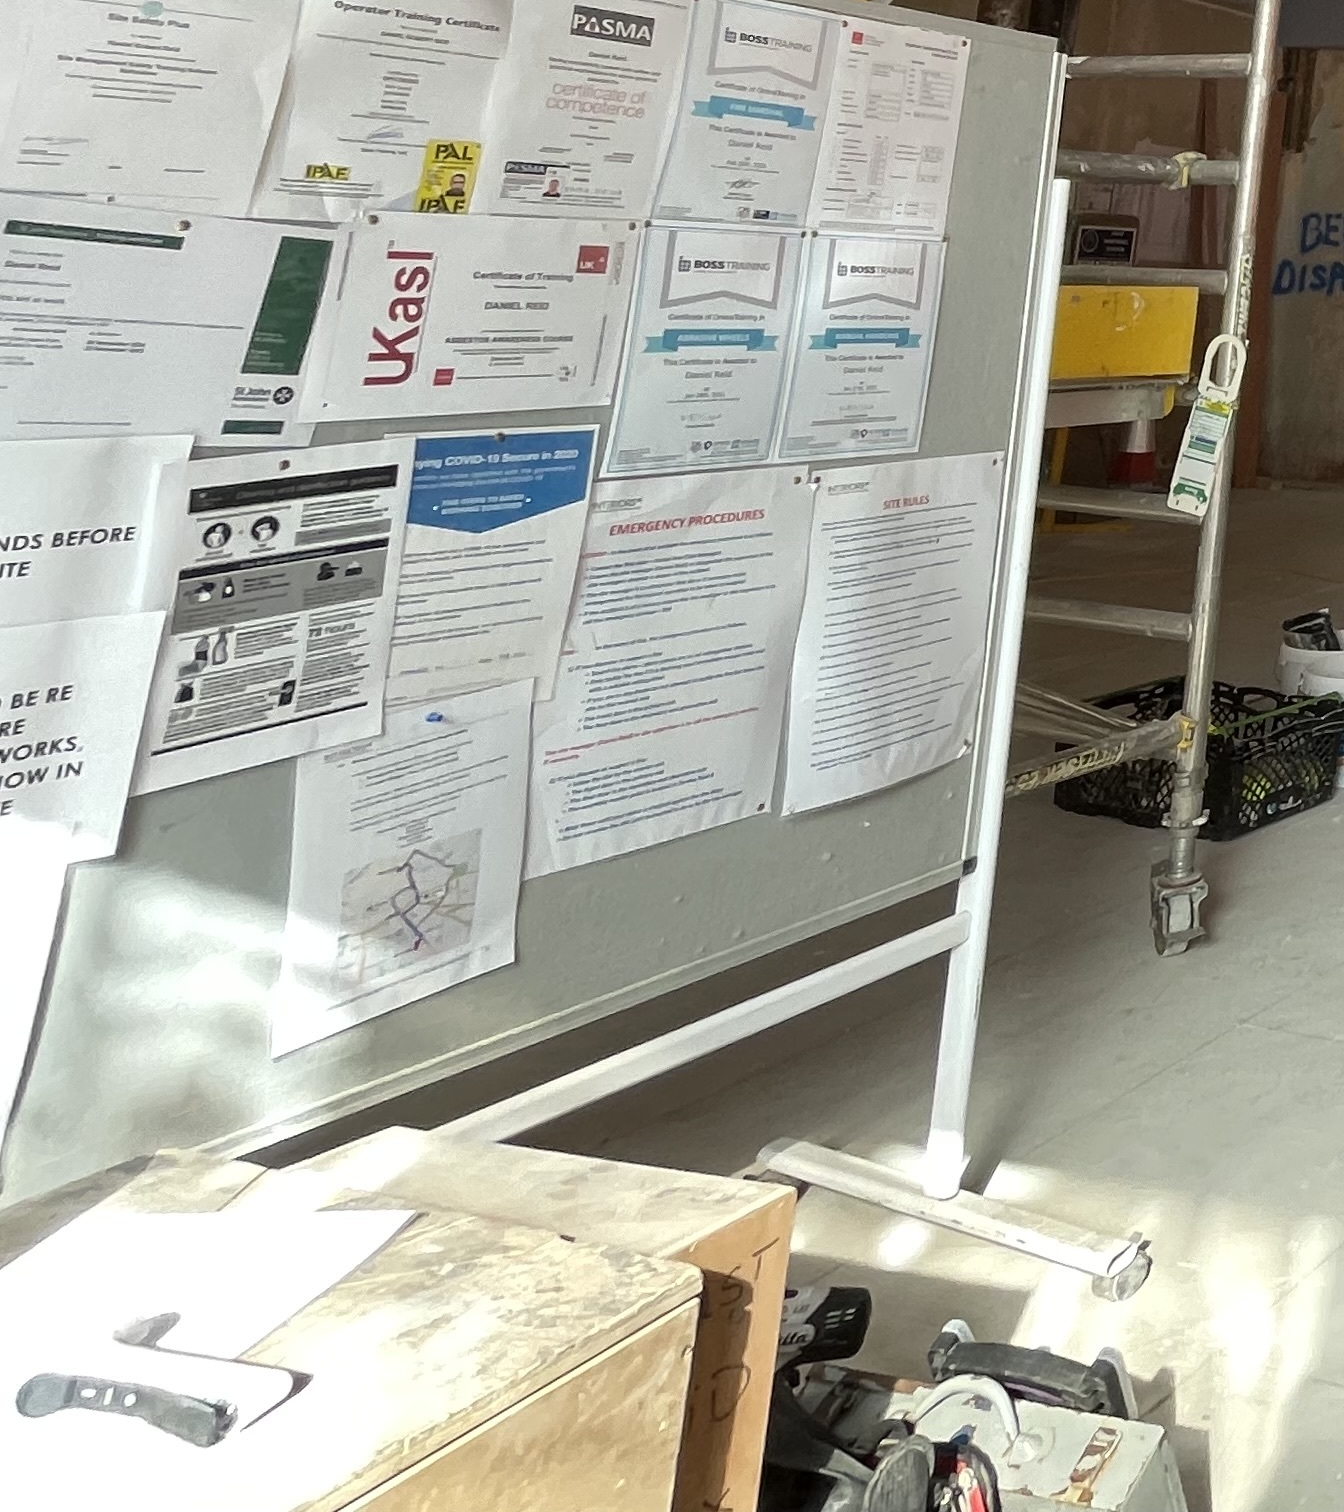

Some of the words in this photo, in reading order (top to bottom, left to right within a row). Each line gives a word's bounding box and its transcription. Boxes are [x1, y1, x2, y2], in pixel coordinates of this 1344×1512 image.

[334, 0, 391, 15] Operator
[394, 9, 442, 25] Training
[446, 17, 500, 32] Certificate
[573, 13, 651, 41] PASMA
[435, 142, 474, 161] PAL
[305, 163, 349, 180] IPAF
[445, 453, 499, 467] COVID-19
[883, 498, 902, 510] SITE
[903, 495, 930, 508] RULES
[609, 518, 686, 536] EMERGENCY
[688, 508, 766, 527] PROCEDURES
[52, 526, 136, 548] BEFORE
[10, 690, 40, 709] BE
[45, 685, 74, 704] RE
[0, 766, 50, 789] OW
[56, 761, 83, 780] IN
